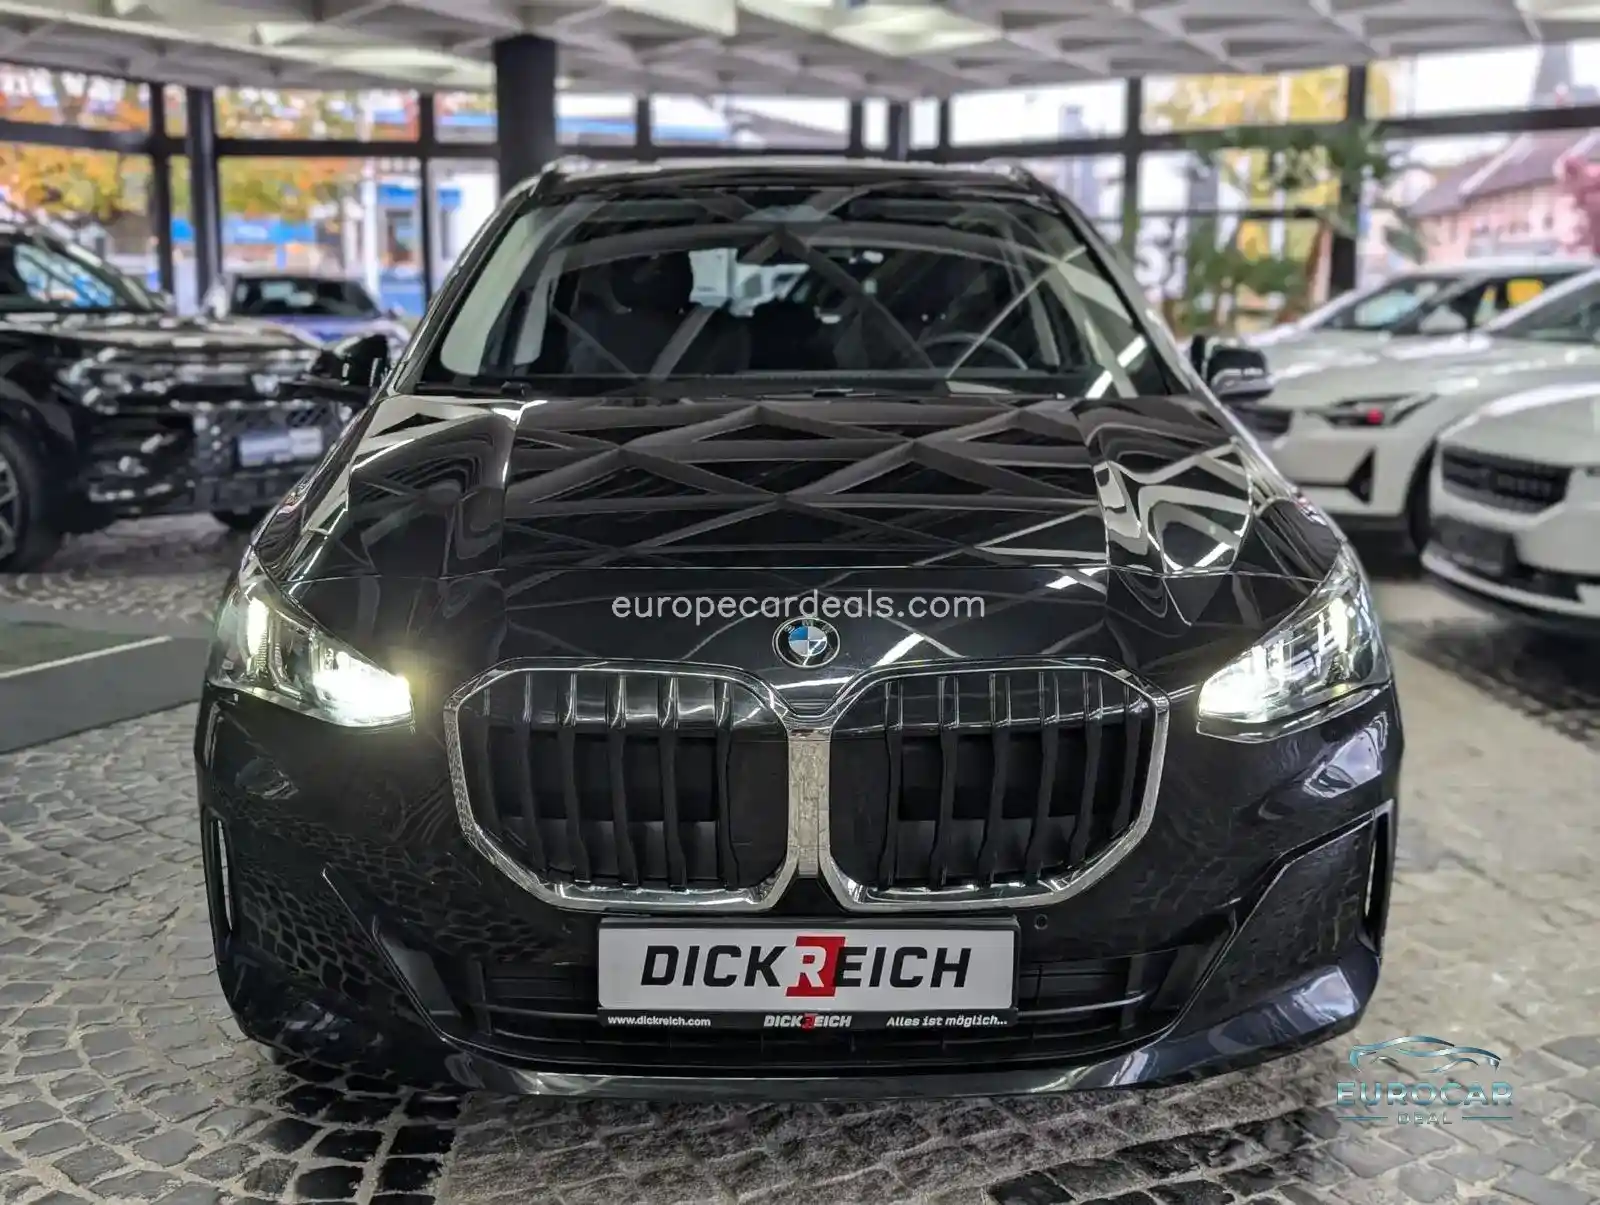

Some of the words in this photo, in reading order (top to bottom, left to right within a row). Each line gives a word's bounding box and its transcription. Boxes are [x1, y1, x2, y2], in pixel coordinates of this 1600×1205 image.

[641, 943, 972, 990] DICKREICH
[607, 1015, 711, 1026] www.dickreich.com
[886, 1016, 920, 1027] Alles
[922, 1015, 943, 1026] ist
